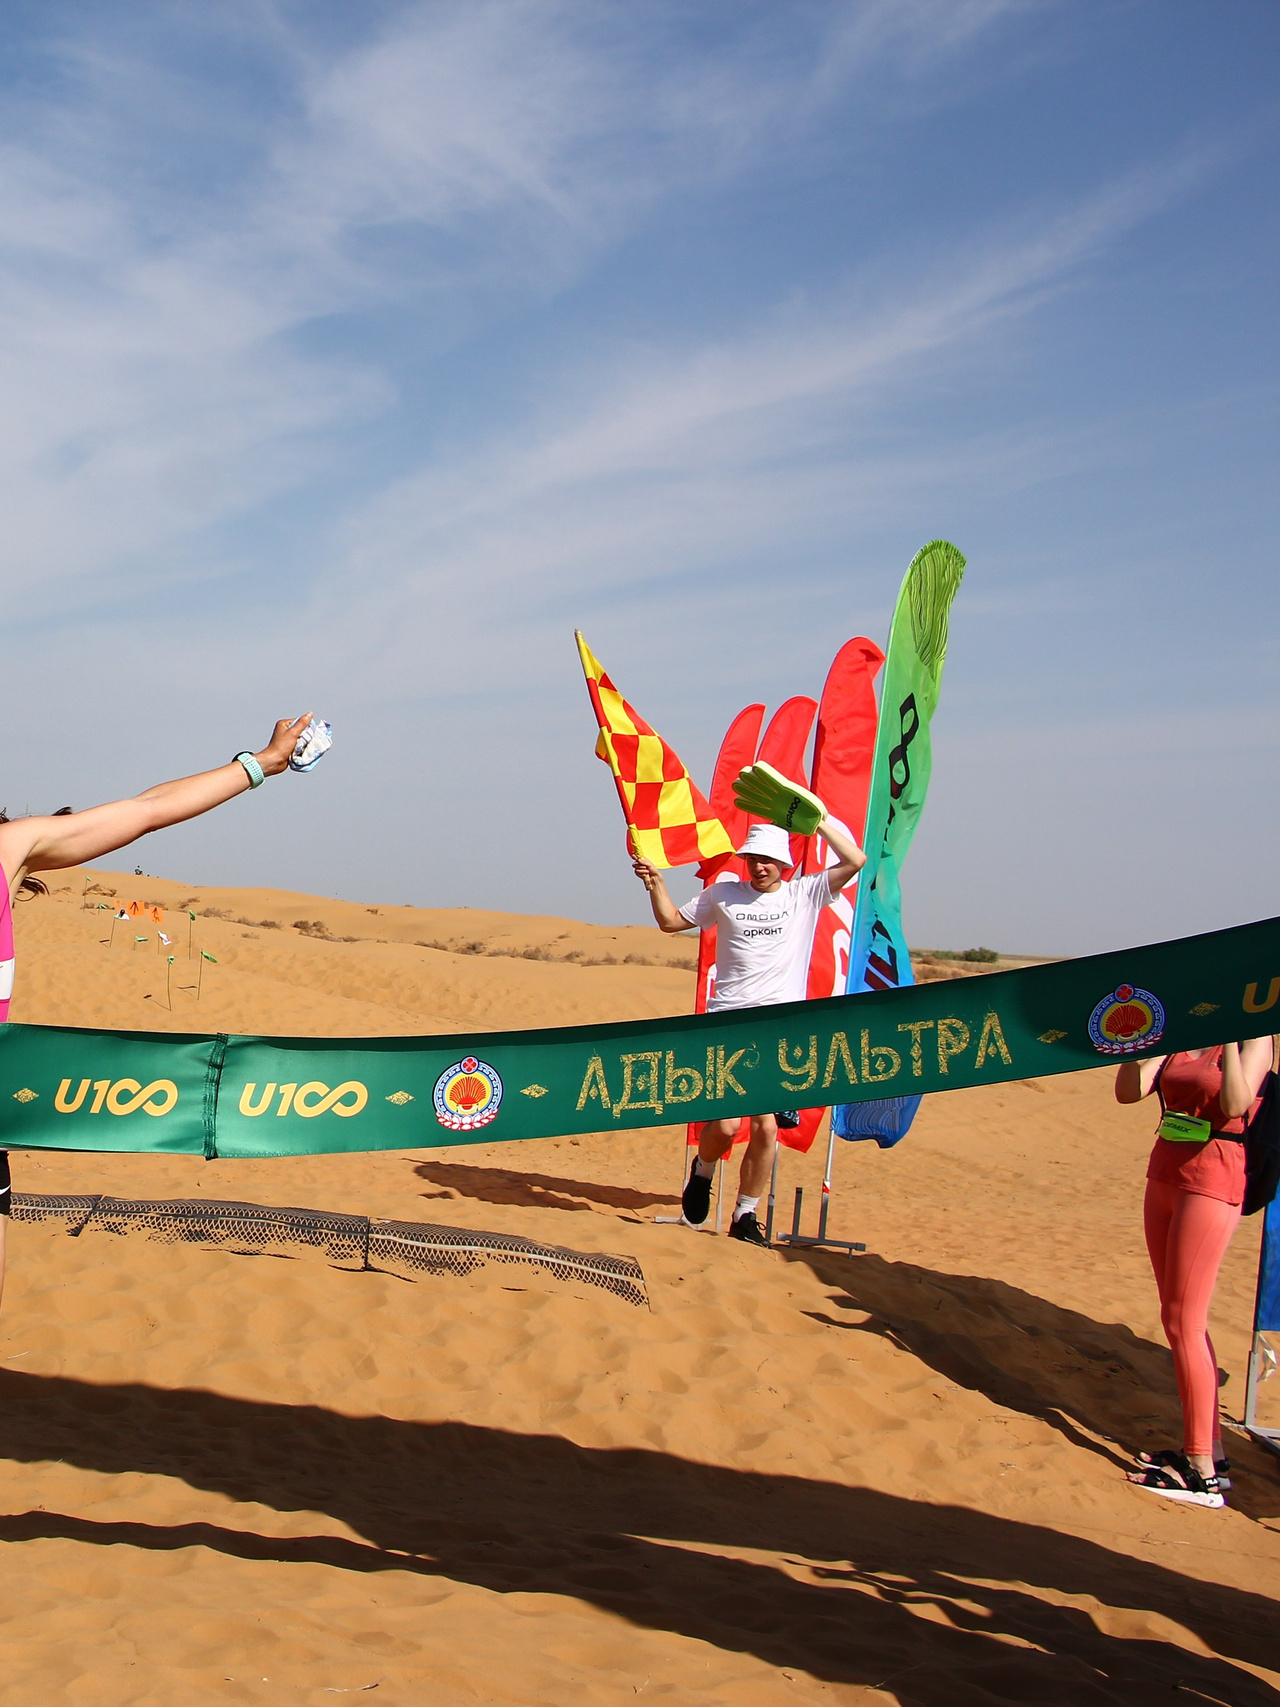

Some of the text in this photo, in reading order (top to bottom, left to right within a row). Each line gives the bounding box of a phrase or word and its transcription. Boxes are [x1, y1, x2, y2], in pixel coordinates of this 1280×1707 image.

[743, 926, 783, 939] арконт
[575, 1008, 1012, 1119] АДЫК УЛЬТРА
